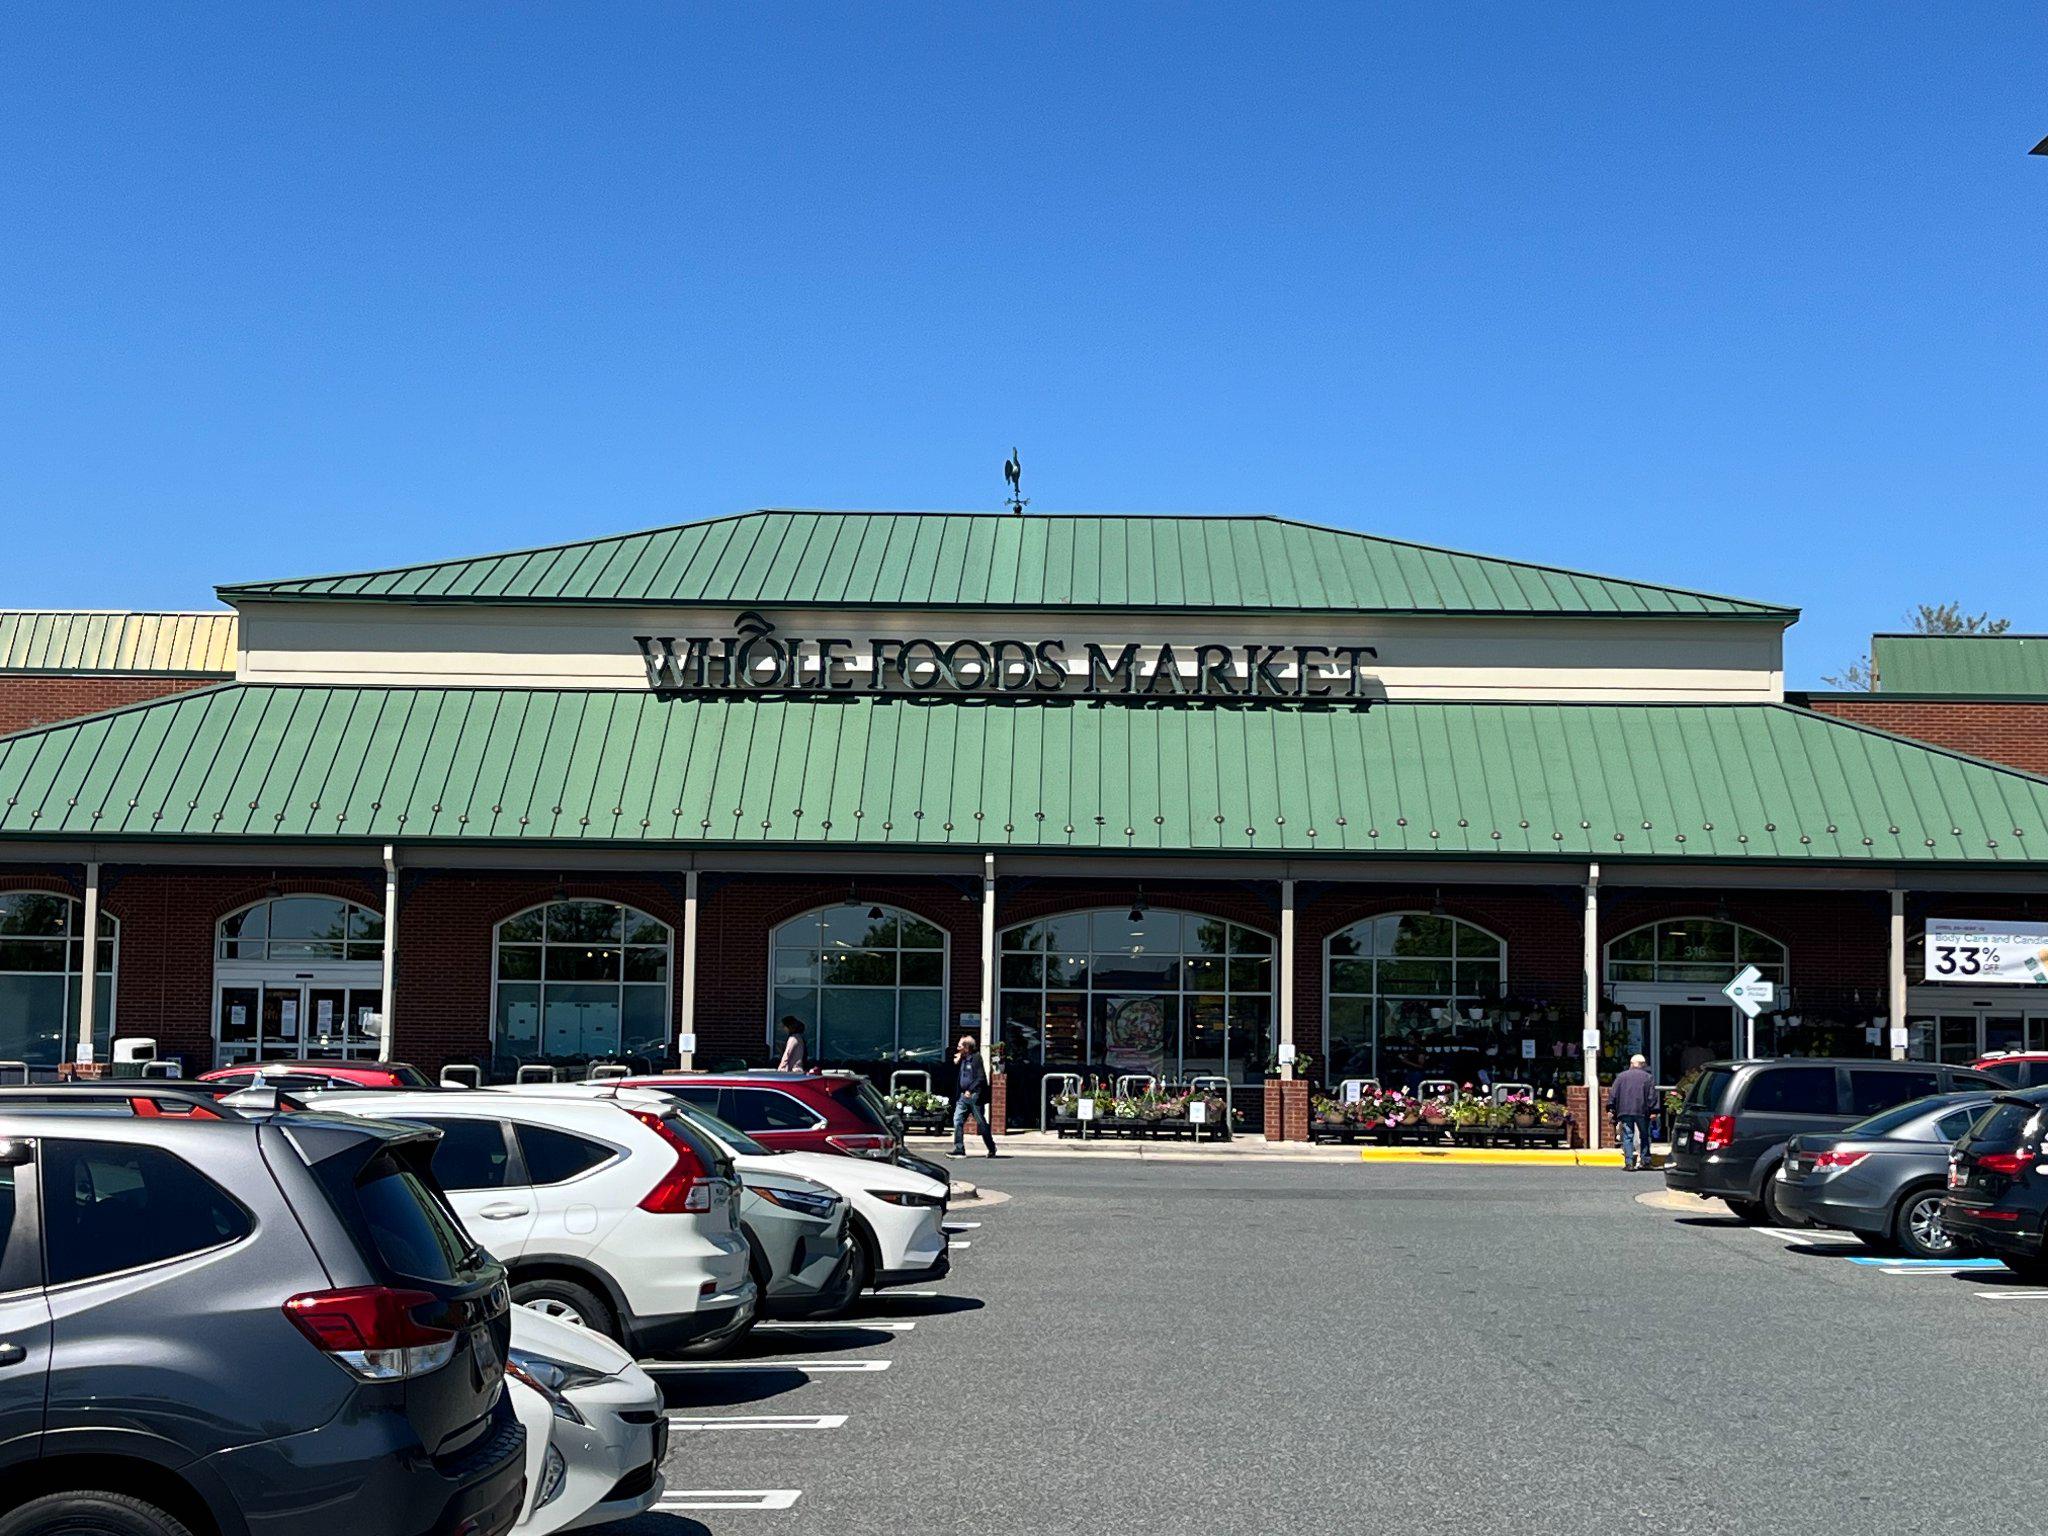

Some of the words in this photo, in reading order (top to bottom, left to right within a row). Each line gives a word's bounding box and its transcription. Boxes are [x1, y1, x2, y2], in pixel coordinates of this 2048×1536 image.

[633, 611, 853, 689] WHOLE
[868, 638, 1067, 691] FOODS
[1083, 642, 1378, 697] MARKET
[1935, 932, 1961, 944] Body
[1964, 933, 1988, 943] Care
[1991, 934, 2010, 944] and
[1982, 963, 2000, 971] OFF
